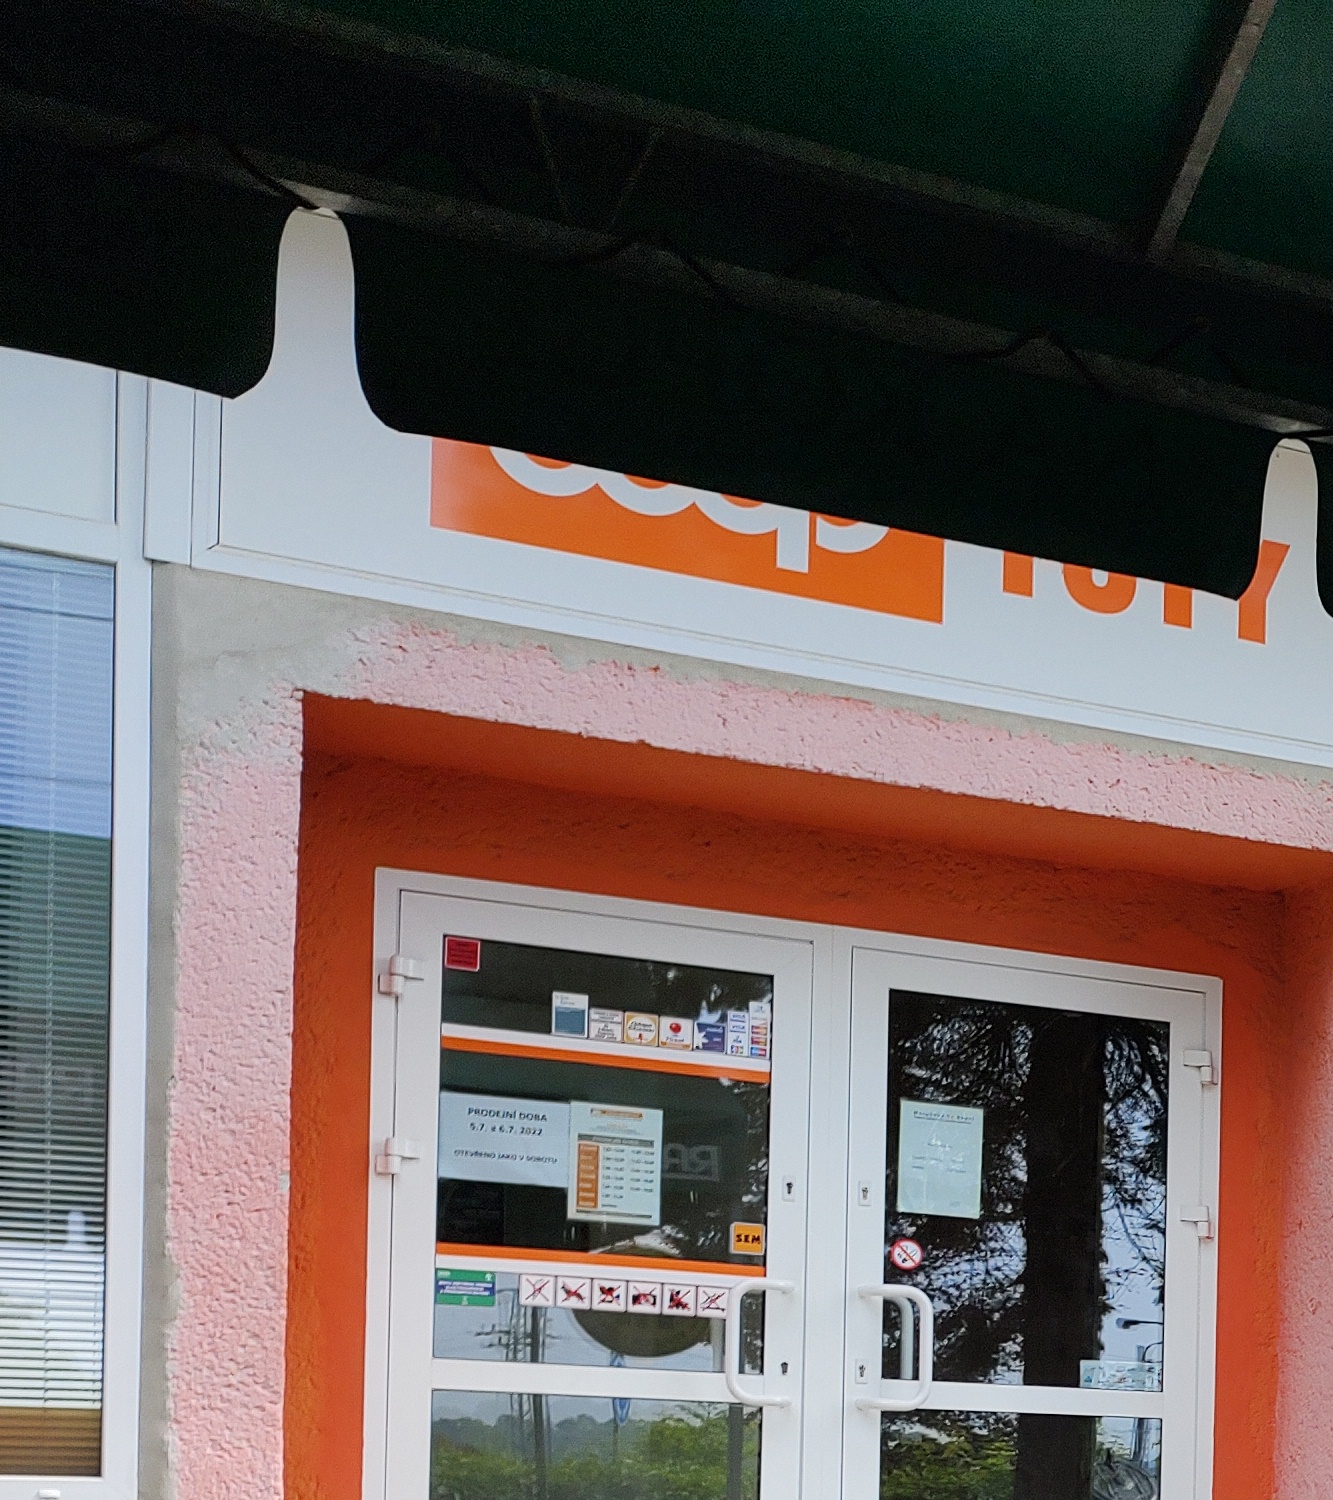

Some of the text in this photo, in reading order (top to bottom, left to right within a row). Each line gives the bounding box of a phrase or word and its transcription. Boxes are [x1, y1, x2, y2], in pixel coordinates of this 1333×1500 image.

[467, 1106, 548, 1122] PRODEJNÍ DOBA
[736, 1232, 762, 1245] SEM
